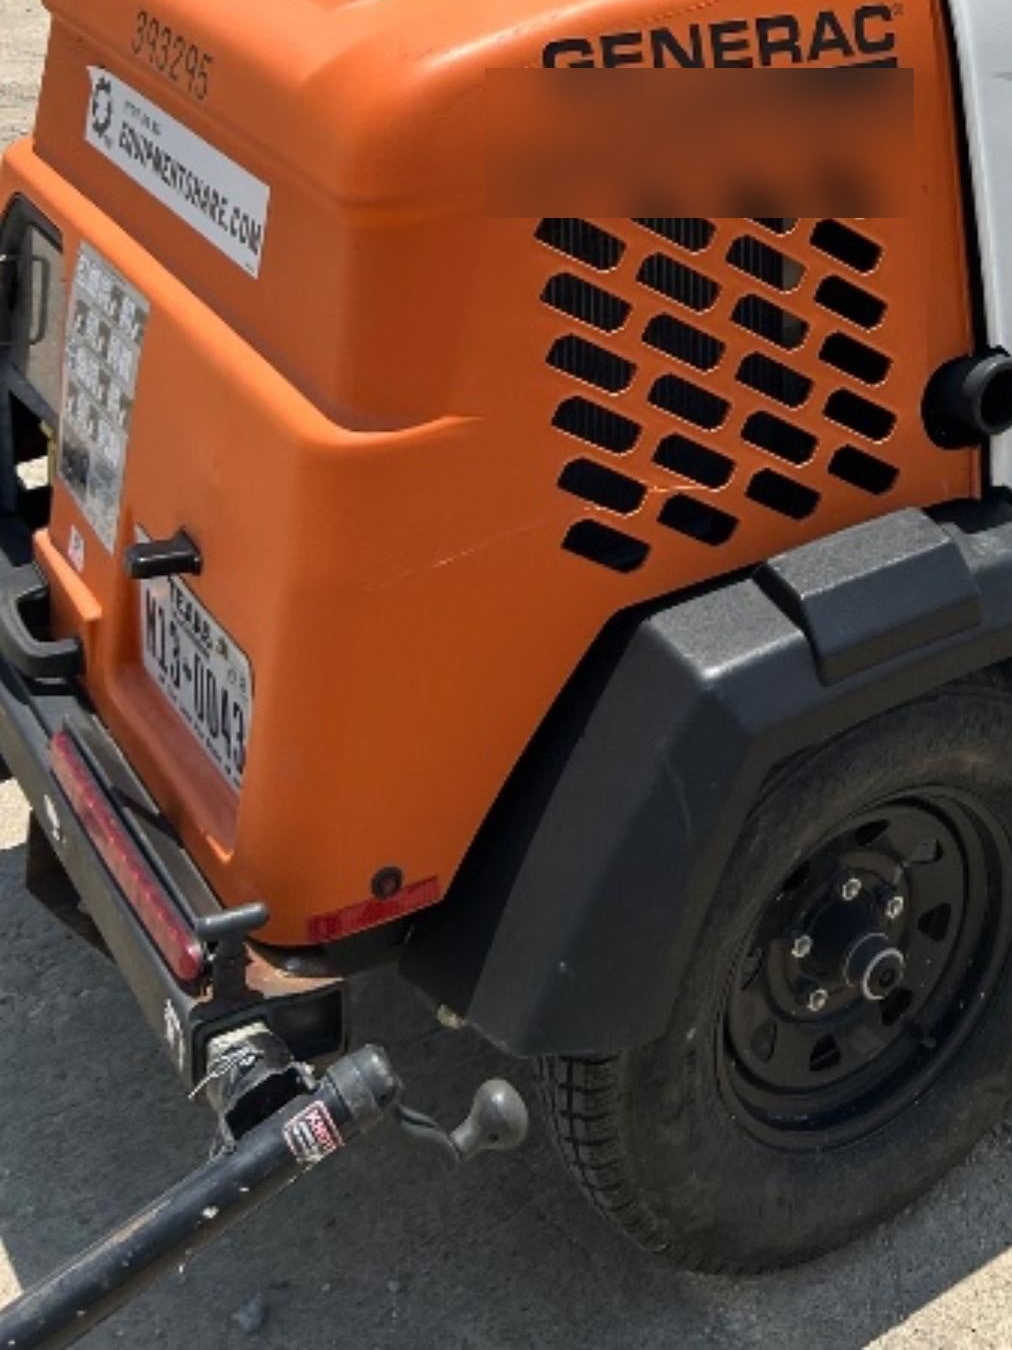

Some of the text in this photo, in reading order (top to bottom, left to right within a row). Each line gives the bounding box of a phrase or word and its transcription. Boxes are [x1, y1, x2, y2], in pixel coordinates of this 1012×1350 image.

[131, 10, 212, 100] 393295
[542, 4, 895, 68] GENERAC
[118, 122, 262, 254] EQUIPMENTSHARE.COM
